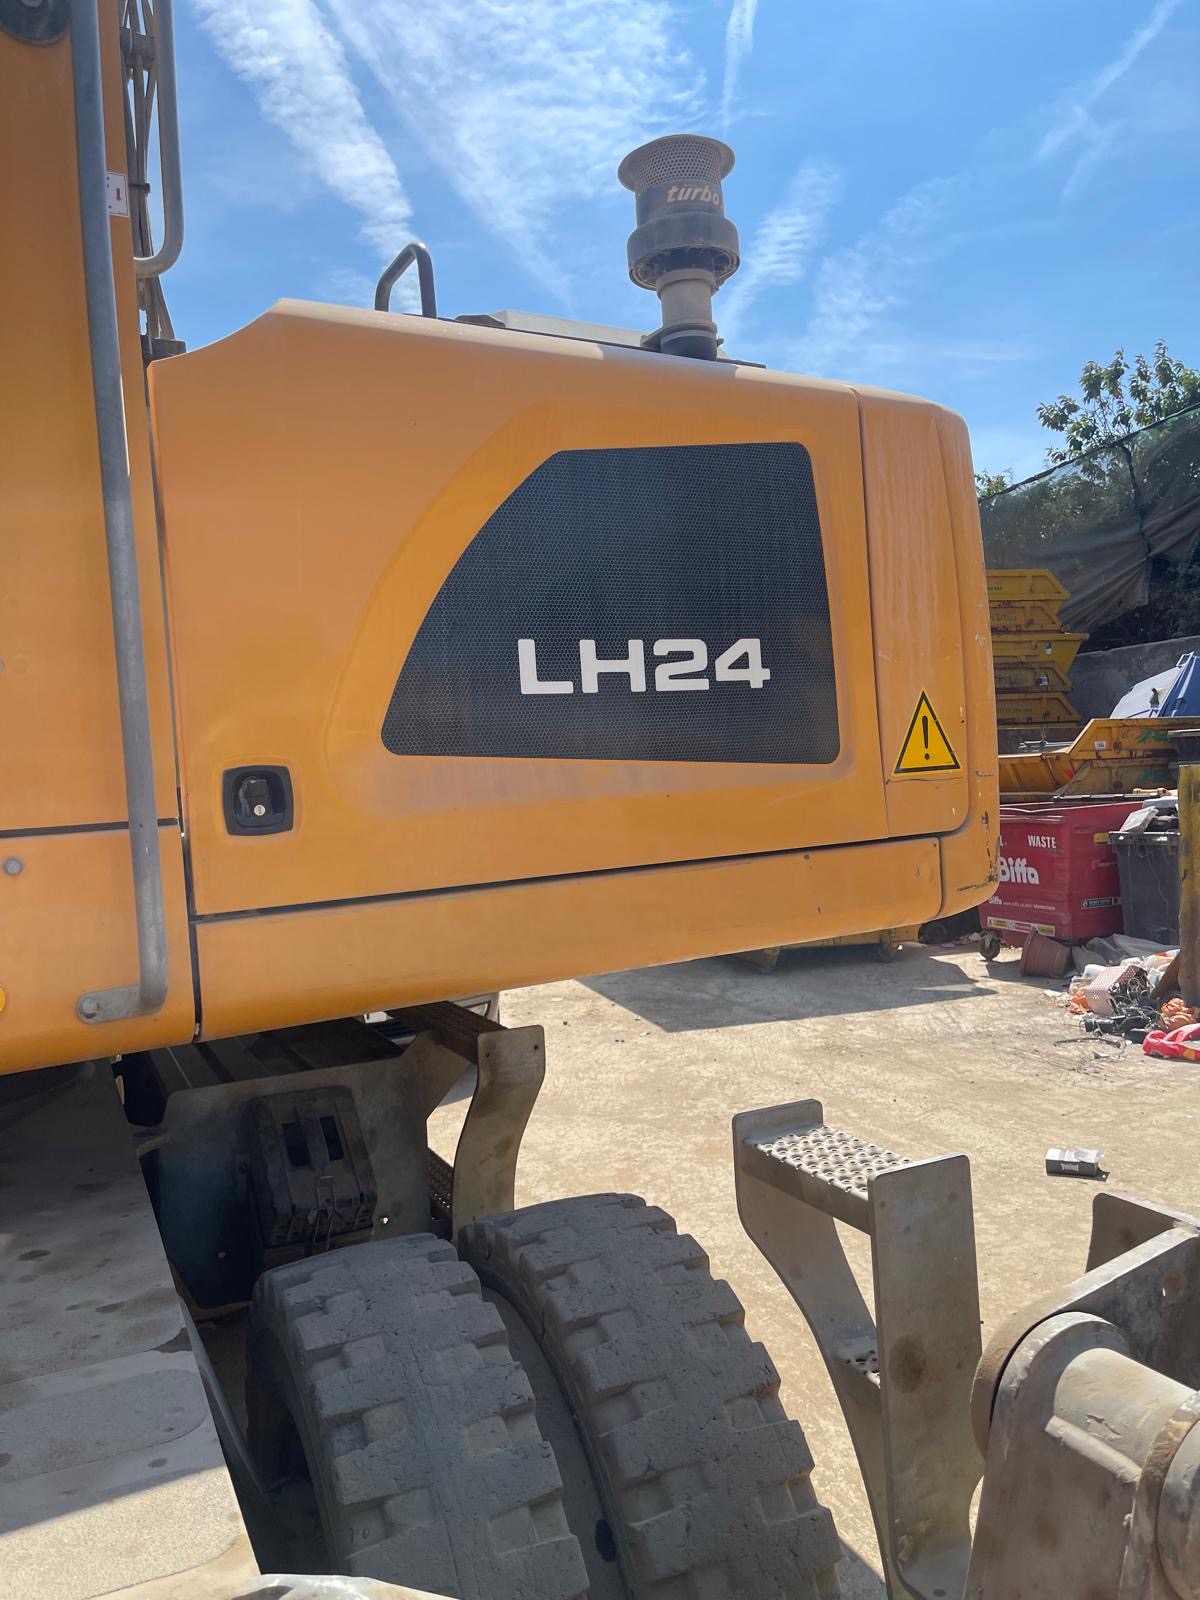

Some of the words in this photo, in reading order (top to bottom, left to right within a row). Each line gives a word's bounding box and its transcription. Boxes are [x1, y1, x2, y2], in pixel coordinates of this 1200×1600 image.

[666, 185, 720, 205] turbo
[517, 638, 771, 695] LH24
[1027, 835, 1057, 849] WASTE
[999, 856, 1040, 885] Biffa
